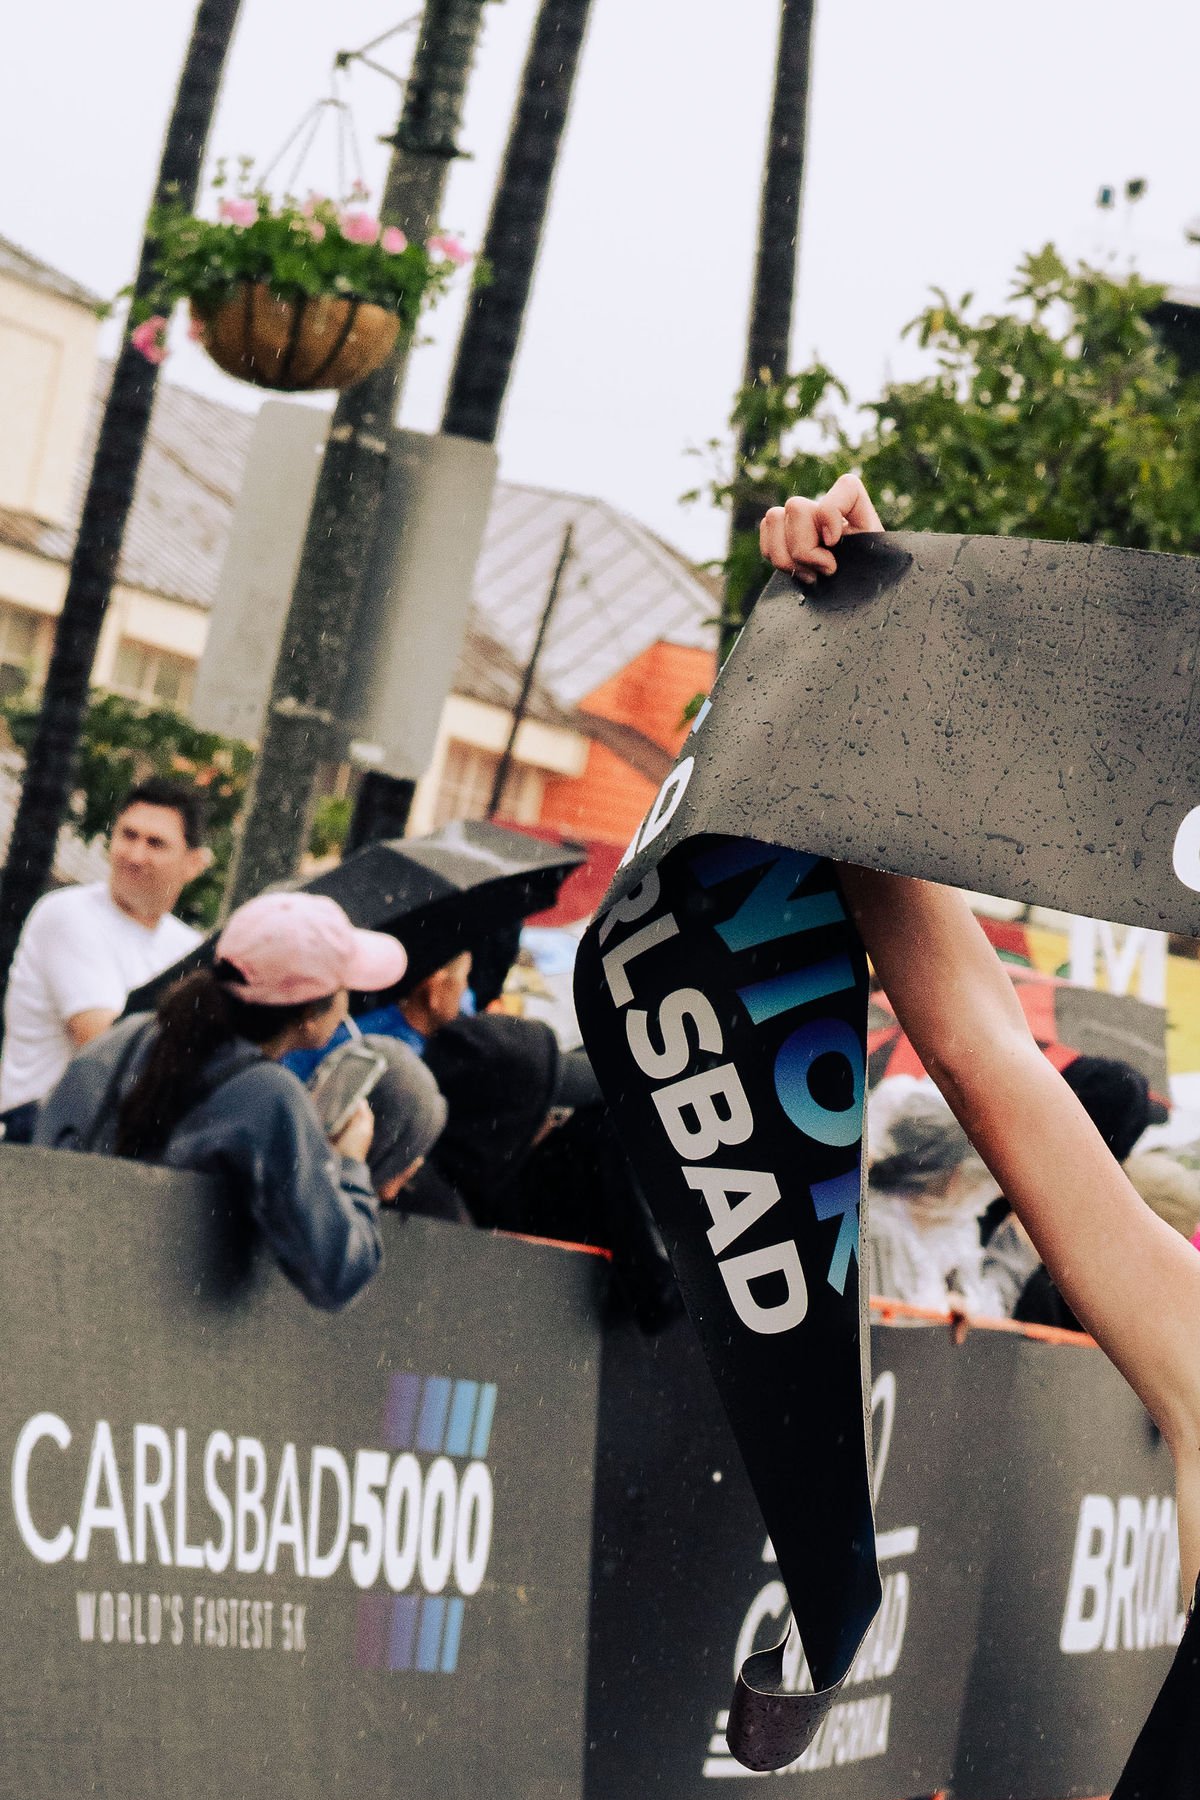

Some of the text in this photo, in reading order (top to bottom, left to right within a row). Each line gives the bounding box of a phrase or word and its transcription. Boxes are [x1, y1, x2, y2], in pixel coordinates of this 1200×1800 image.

[598, 866, 808, 1334] RLSBAD
[11, 1411, 495, 1595] CARLSBAD5000
[77, 1591, 184, 1646] WORLD'S
[194, 1595, 273, 1649] FASTEST
